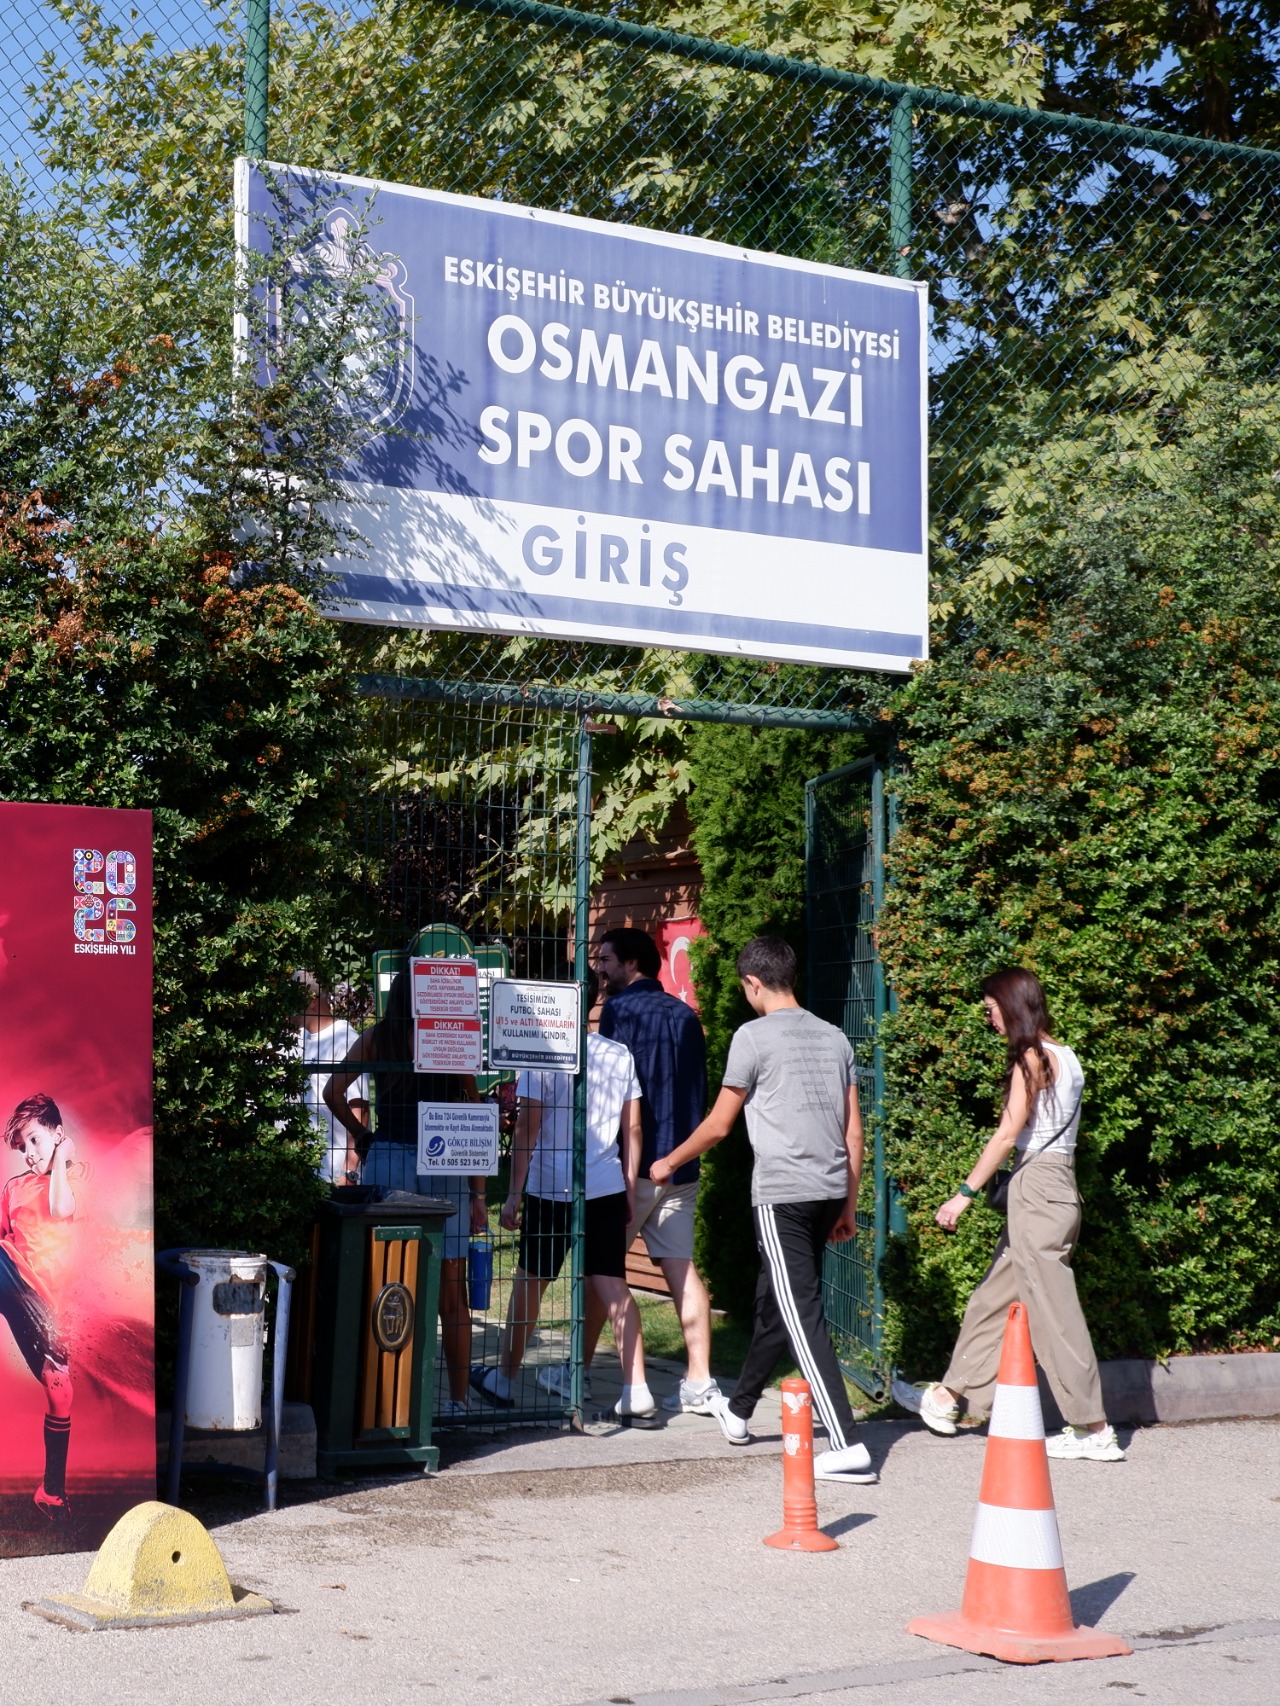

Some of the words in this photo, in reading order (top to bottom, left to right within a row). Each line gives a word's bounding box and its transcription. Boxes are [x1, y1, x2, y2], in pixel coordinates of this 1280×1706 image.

[444, 256, 584, 306] ESKİŞEHİR
[594, 280, 759, 336] BÜYÜKŞEHİR
[767, 315, 900, 360] BELEDİYESİ
[487, 314, 863, 427] OSMANGAZİ
[477, 405, 644, 485] SPOR
[662, 433, 871, 515] SAHASI
[521, 514, 690, 607] GİRİŞ
[74, 942, 119, 956] ESKİŞEHİR
[120, 945, 136, 955] YILI
[430, 966, 461, 976] DİKKAT!
[510, 1005, 535, 1015] FUTBOL
[537, 1006, 561, 1016] SAHASI
[434, 1020, 465, 1030] DİKKAT!
[520, 1017, 533, 1027] ALTI
[536, 1018, 575, 1029] TAKIMLARIN
[502, 1028, 539, 1039] KULLANIMI
[511, 1051, 544, 1060] BÜYÜKŞEHİR
[545, 1054, 574, 1062] BELEDİYESİ
[429, 1112, 434, 1120] Bu
[435, 1112, 443, 1120] Bina
[452, 1112, 467, 1120] Güvenlik
[468, 1113, 489, 1122] Kamerasıyla
[450, 1124, 459, 1133] Kayıt
[447, 1136, 468, 1149] GÖKÇE
[469, 1137, 492, 1149] BİLİŞİM
